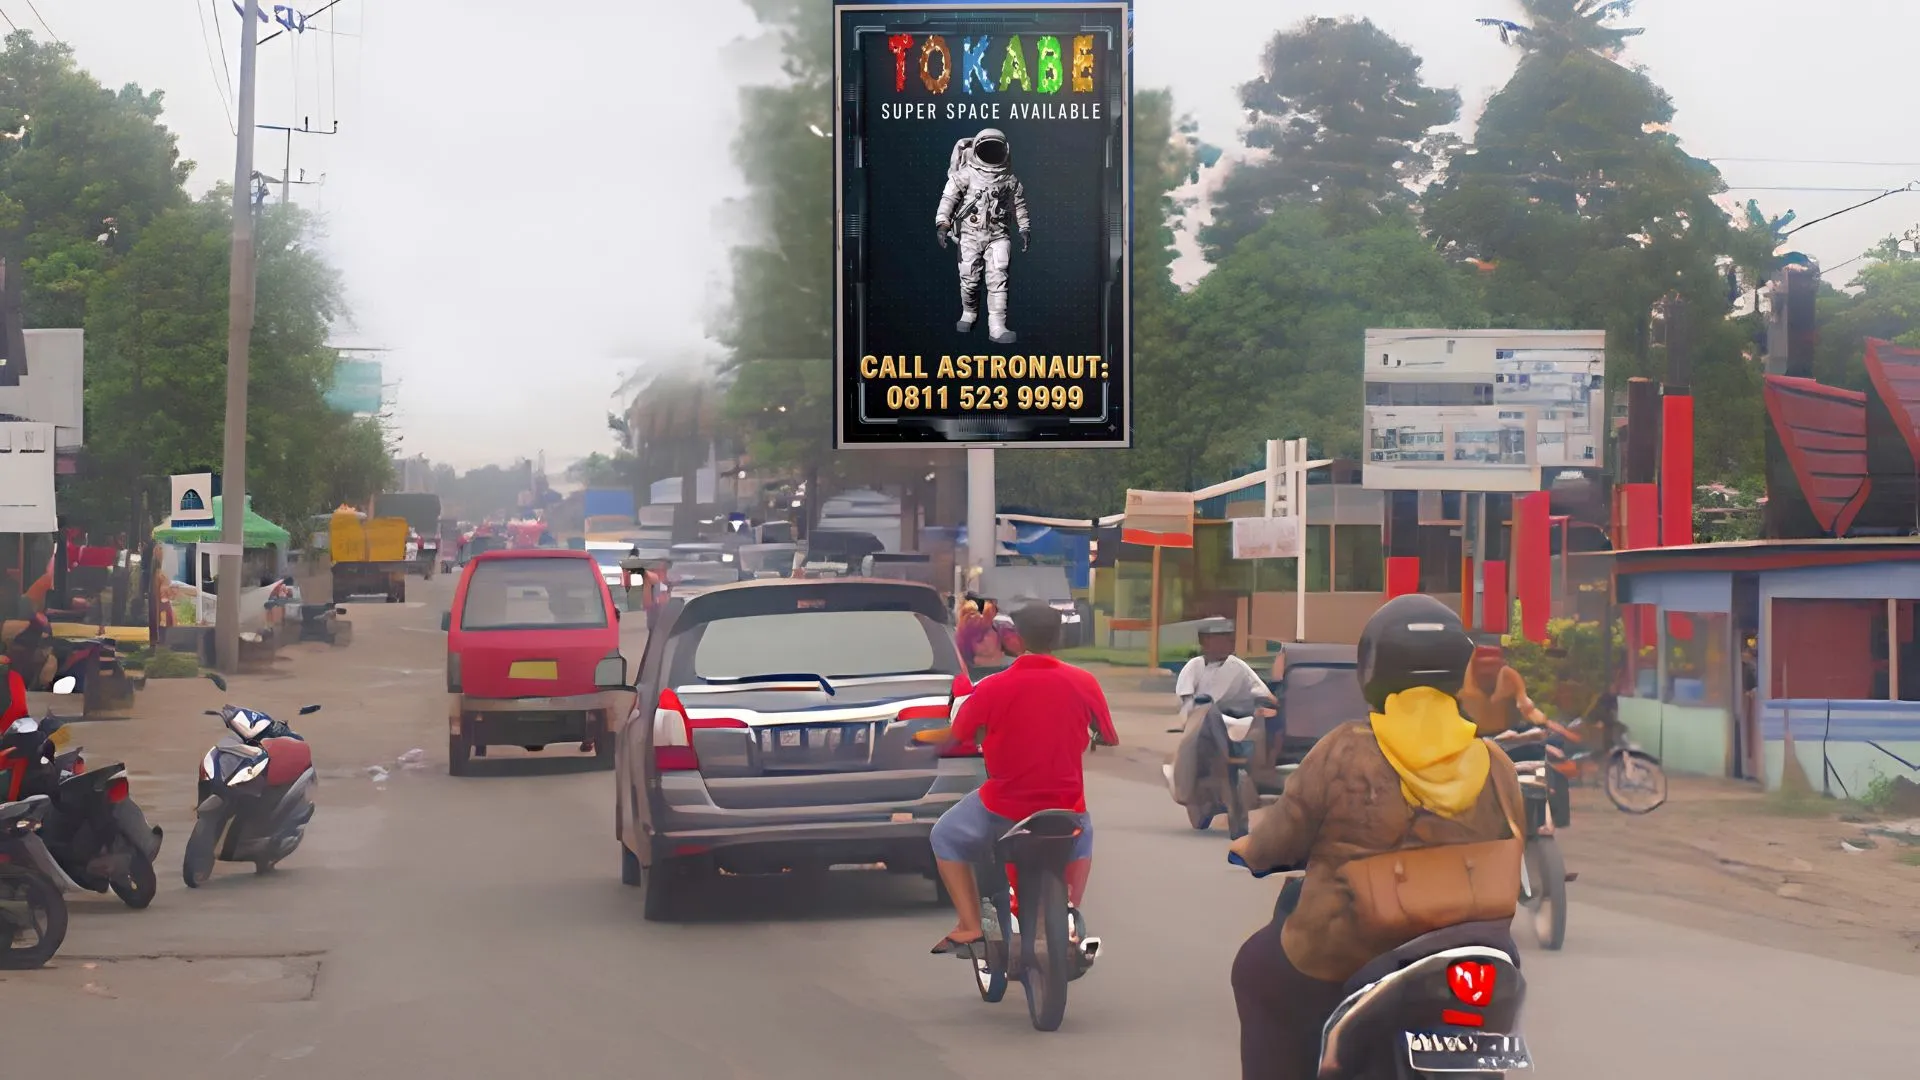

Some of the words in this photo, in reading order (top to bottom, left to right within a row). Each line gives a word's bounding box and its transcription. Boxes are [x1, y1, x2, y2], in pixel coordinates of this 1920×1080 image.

[888, 33, 1096, 95] TOKABE
[881, 103, 936, 120] SUPER
[946, 103, 1000, 120] SPACE
[1009, 103, 1101, 120] AVAILABLE
[860, 355, 928, 379] CALL
[937, 355, 1109, 379] ASTRONAUT:
[886, 385, 948, 410] 0811
[959, 385, 1008, 410] 523
[1017, 385, 1084, 410] 9999
